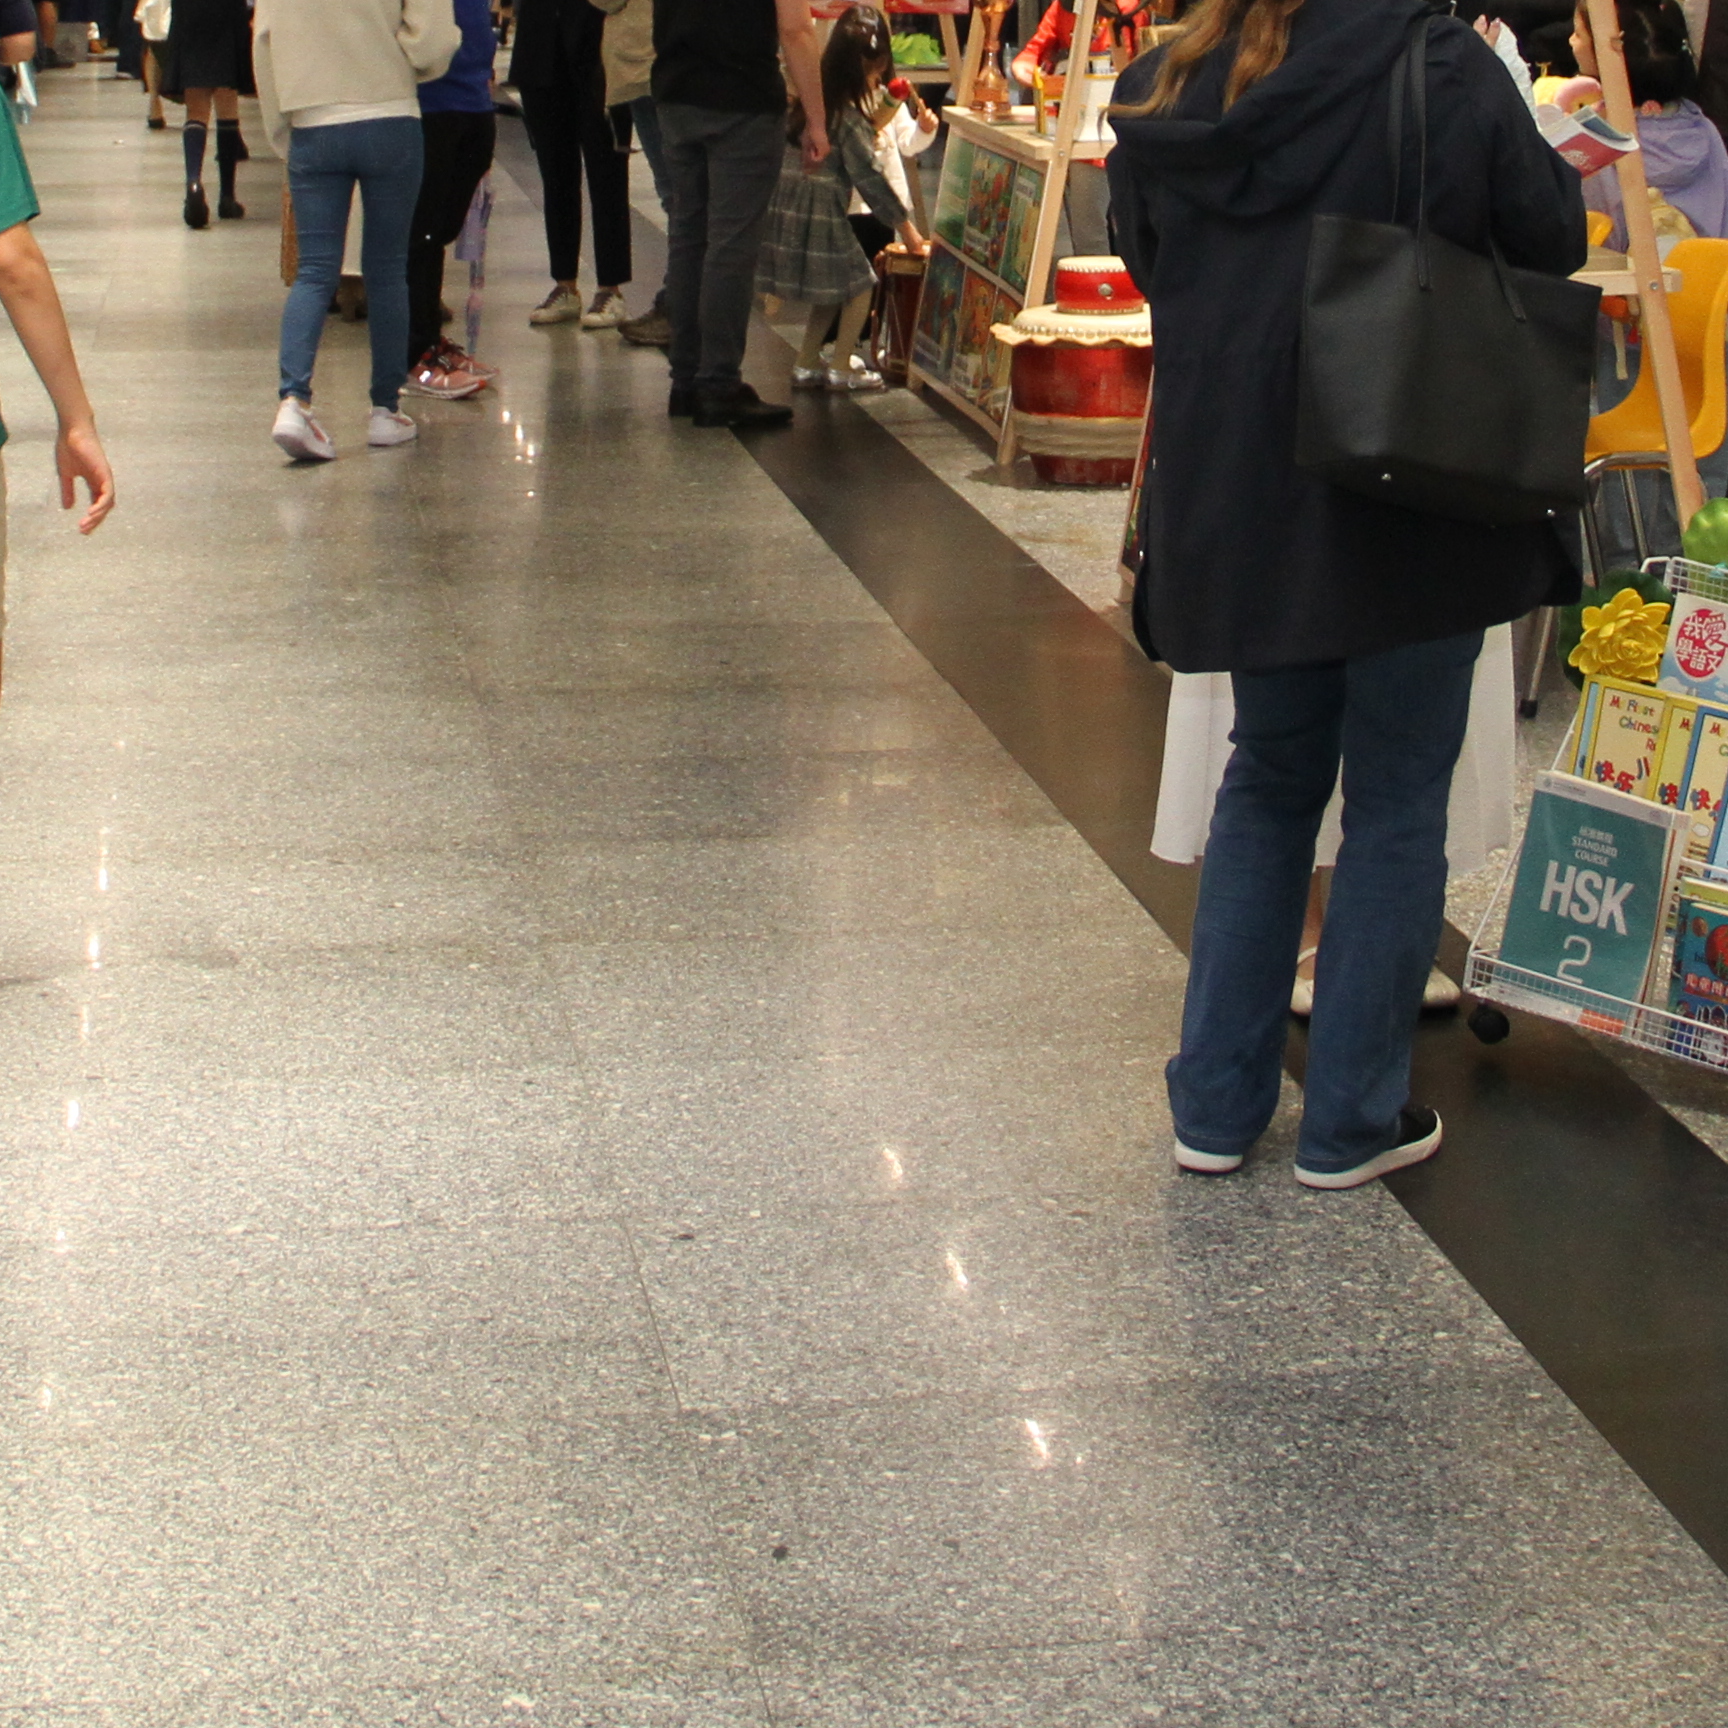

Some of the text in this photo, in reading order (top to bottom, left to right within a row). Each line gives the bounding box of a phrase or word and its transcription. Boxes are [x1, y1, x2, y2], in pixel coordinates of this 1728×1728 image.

[1683, 613, 1727, 650] 我愛
[1677, 638, 1723, 672] 學語文
[1572, 836, 1618, 858] STANDARD
[1575, 848, 1609, 868] COURSE
[1539, 859, 1635, 936] HSK
[1556, 935, 1592, 985] 2
